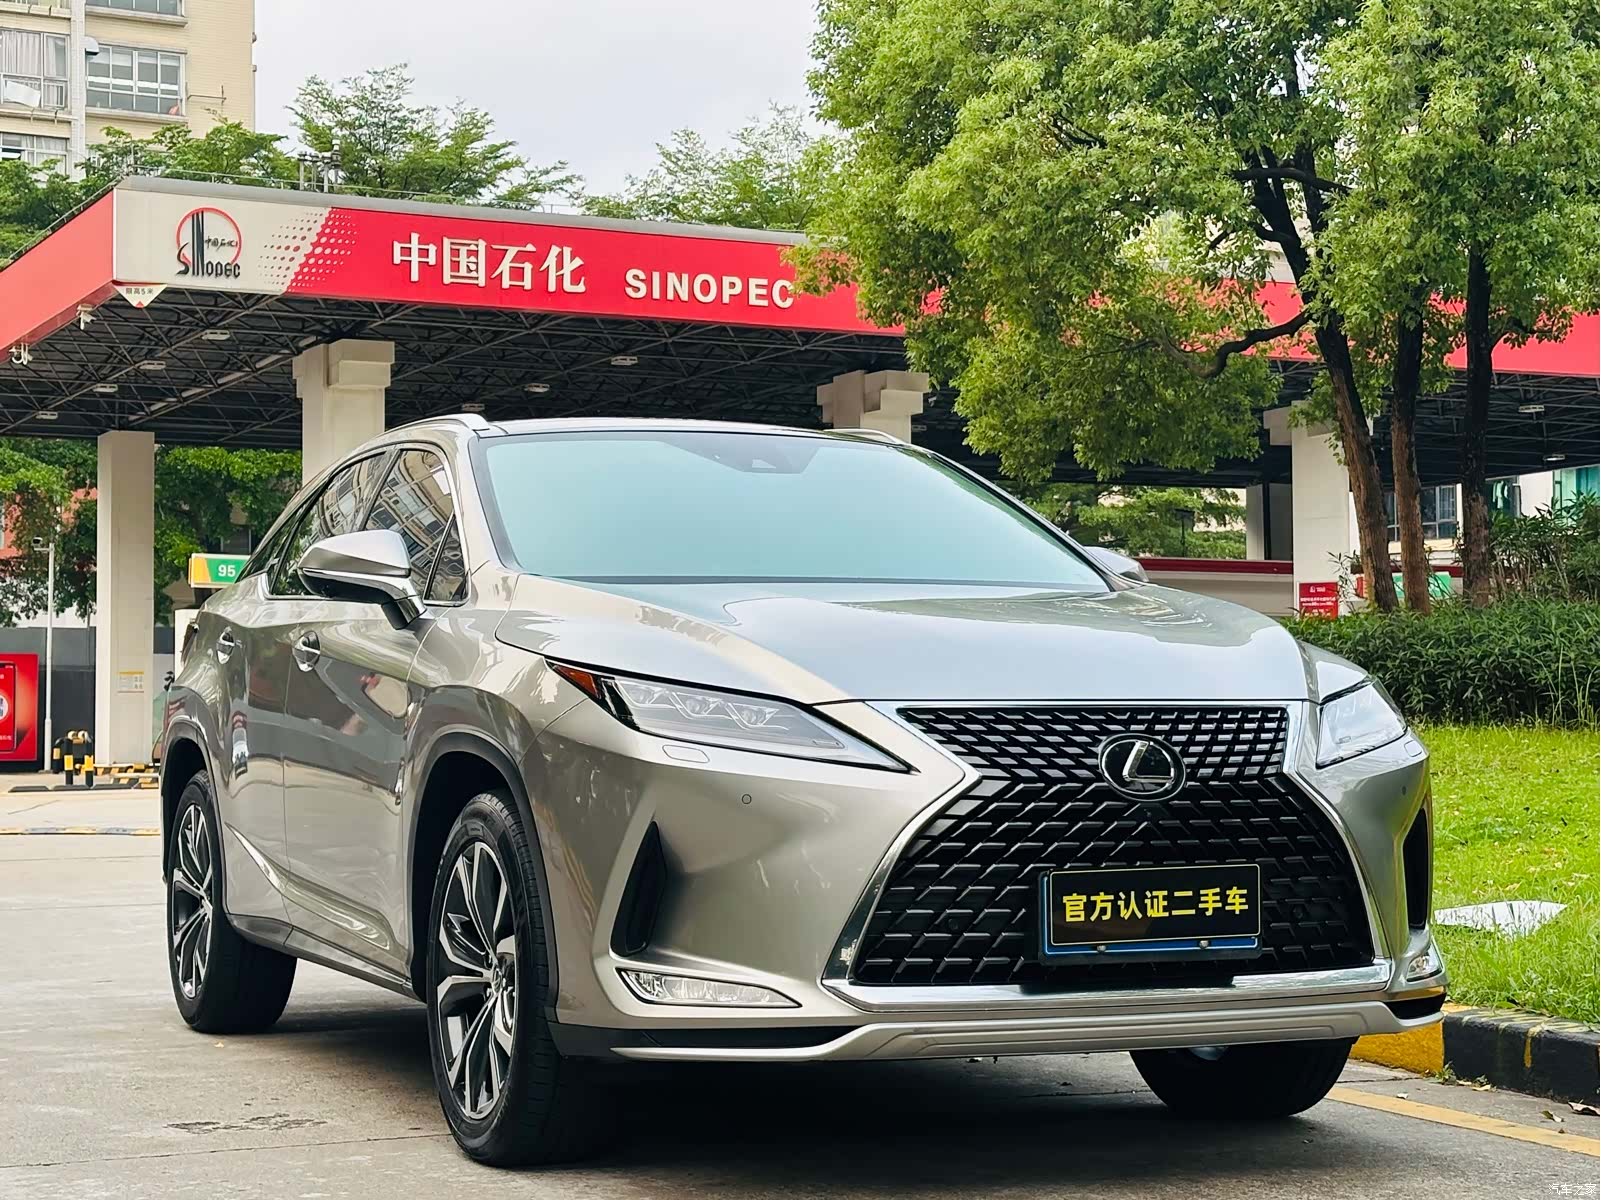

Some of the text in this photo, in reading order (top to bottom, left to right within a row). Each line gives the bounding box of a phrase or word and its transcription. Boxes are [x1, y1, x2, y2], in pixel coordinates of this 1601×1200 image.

[393, 232, 587, 293] 中国石化
[625, 268, 795, 309] SINOPEC
[218, 564, 236, 577] 95
[1062, 887, 1249, 922] 官方认证二手车
